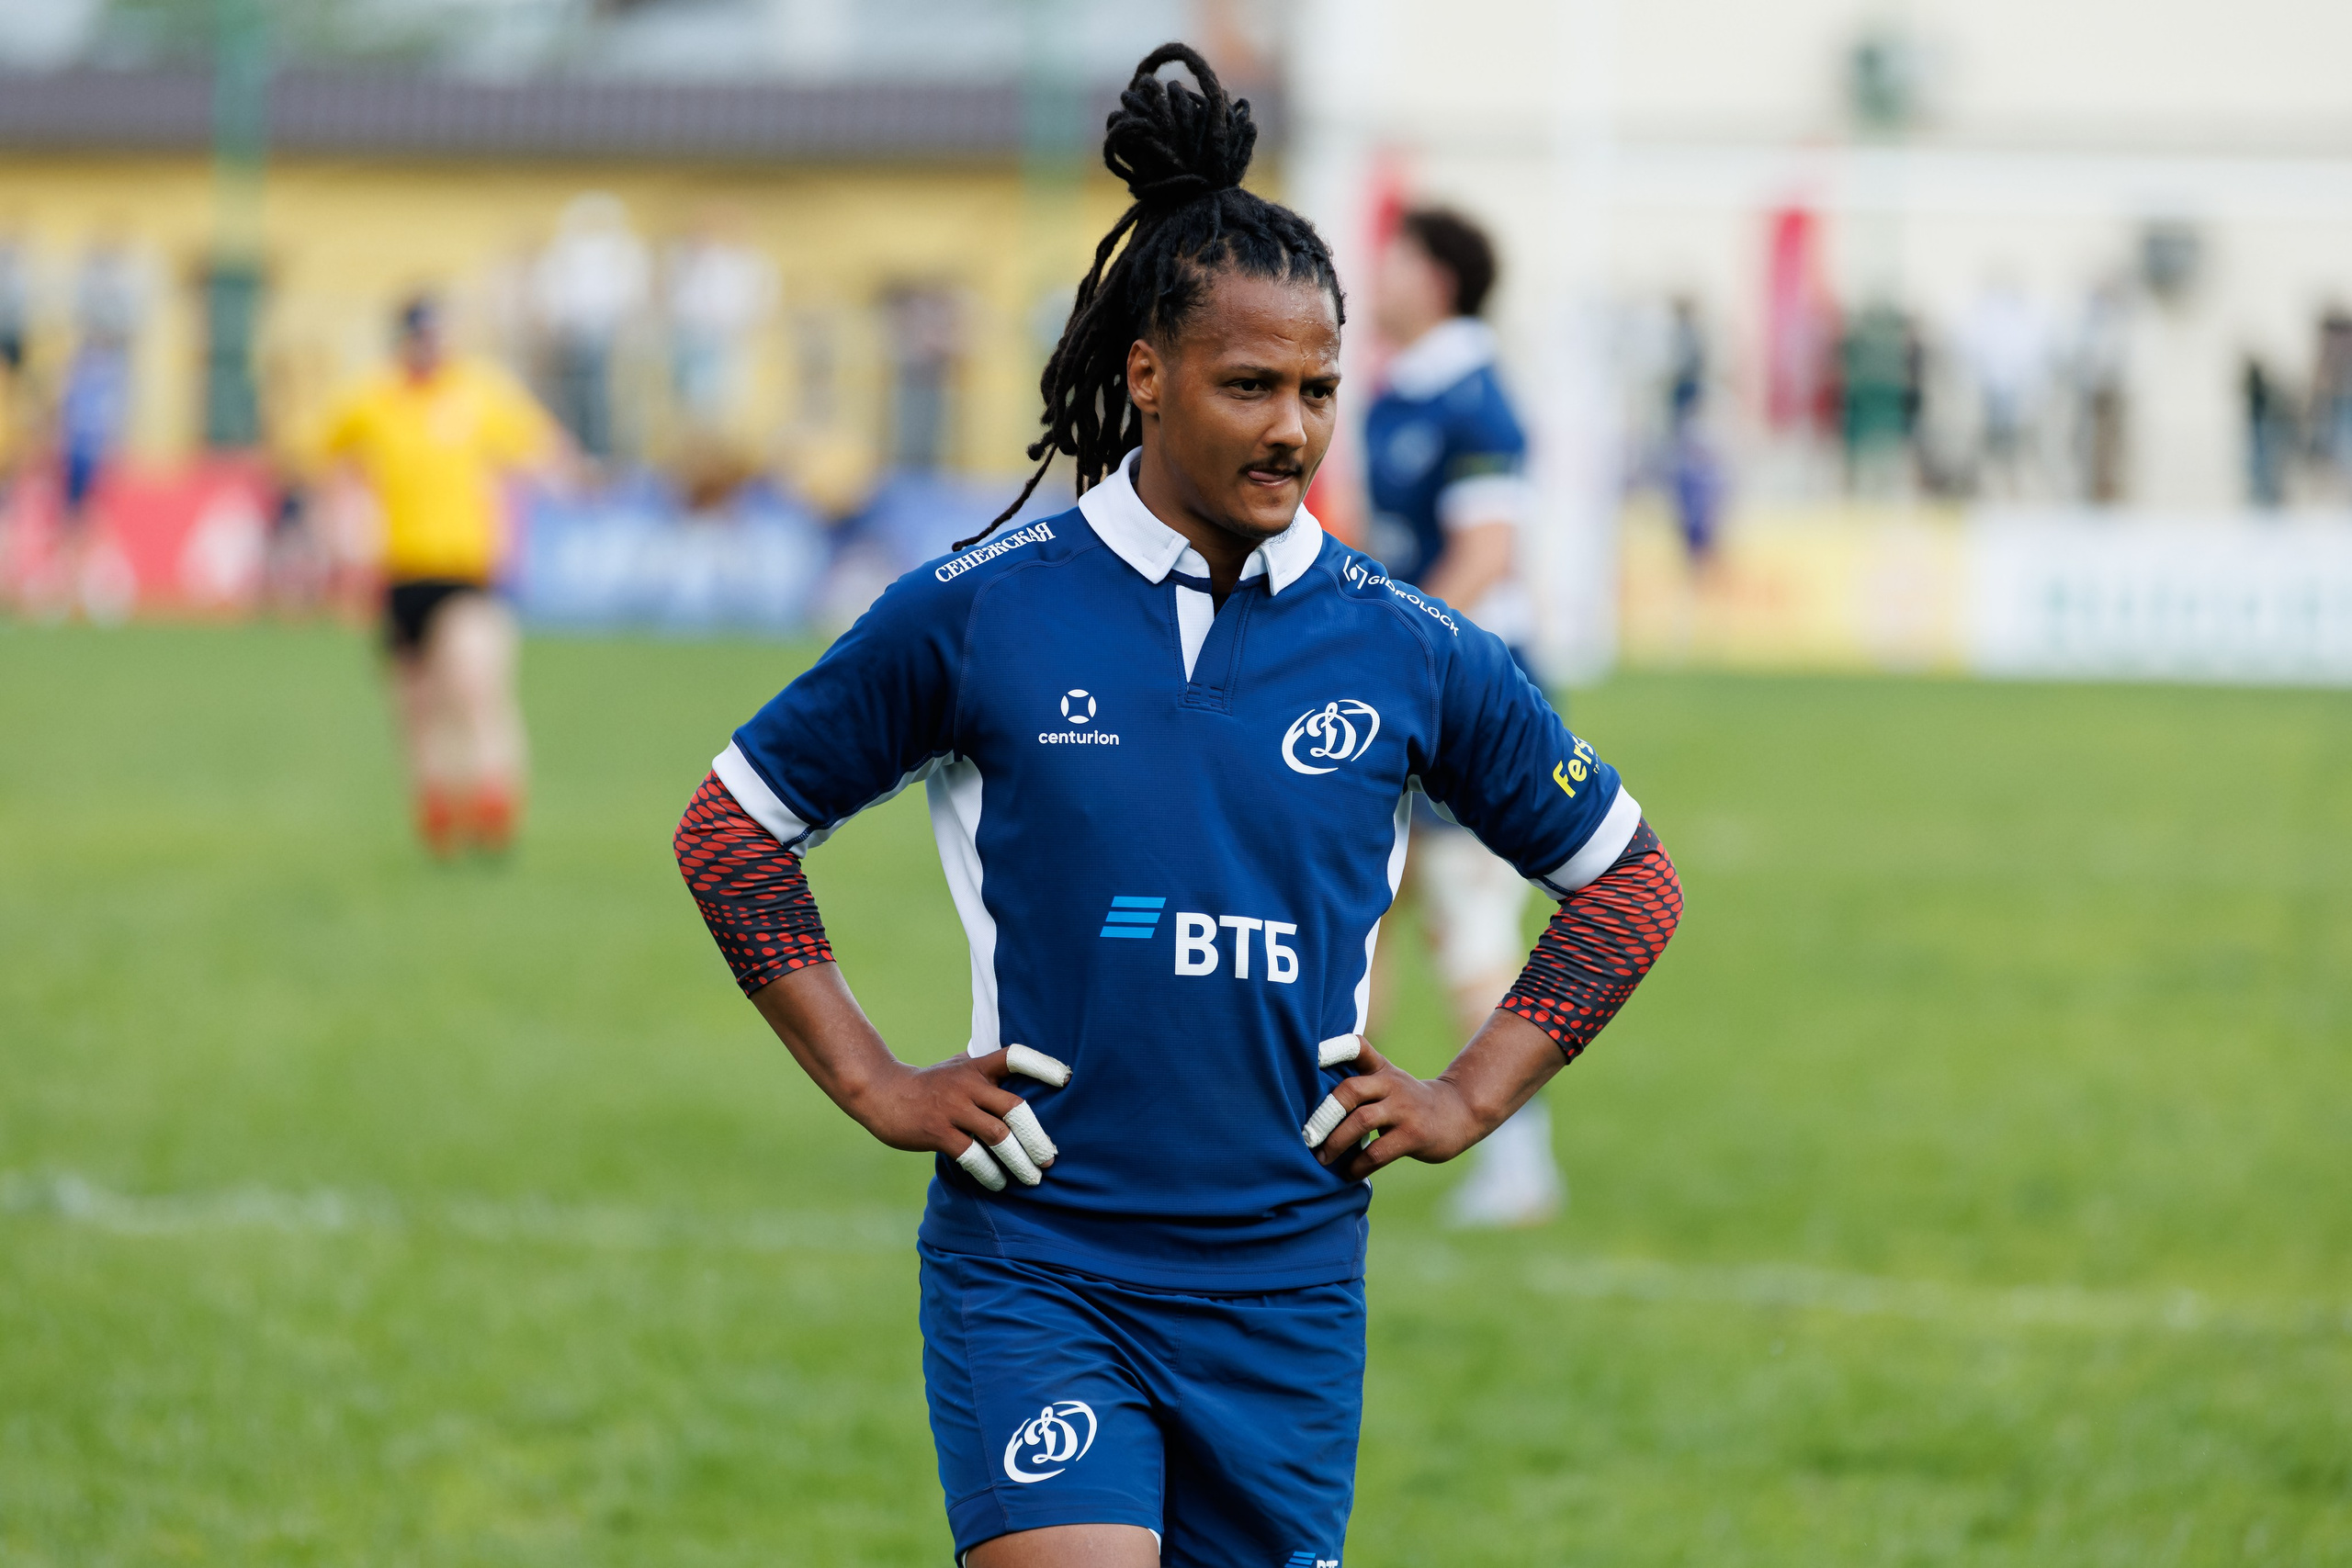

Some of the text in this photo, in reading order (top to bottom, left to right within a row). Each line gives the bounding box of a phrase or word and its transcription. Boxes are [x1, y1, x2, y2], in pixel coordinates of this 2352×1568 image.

[934, 522, 1056, 582] СЕНЕЖСКАЯ
[1368, 575, 1459, 637] GIDROLOCK
[1038, 729, 1120, 745] centurion
[1174, 912, 1299, 984] ВТБ
